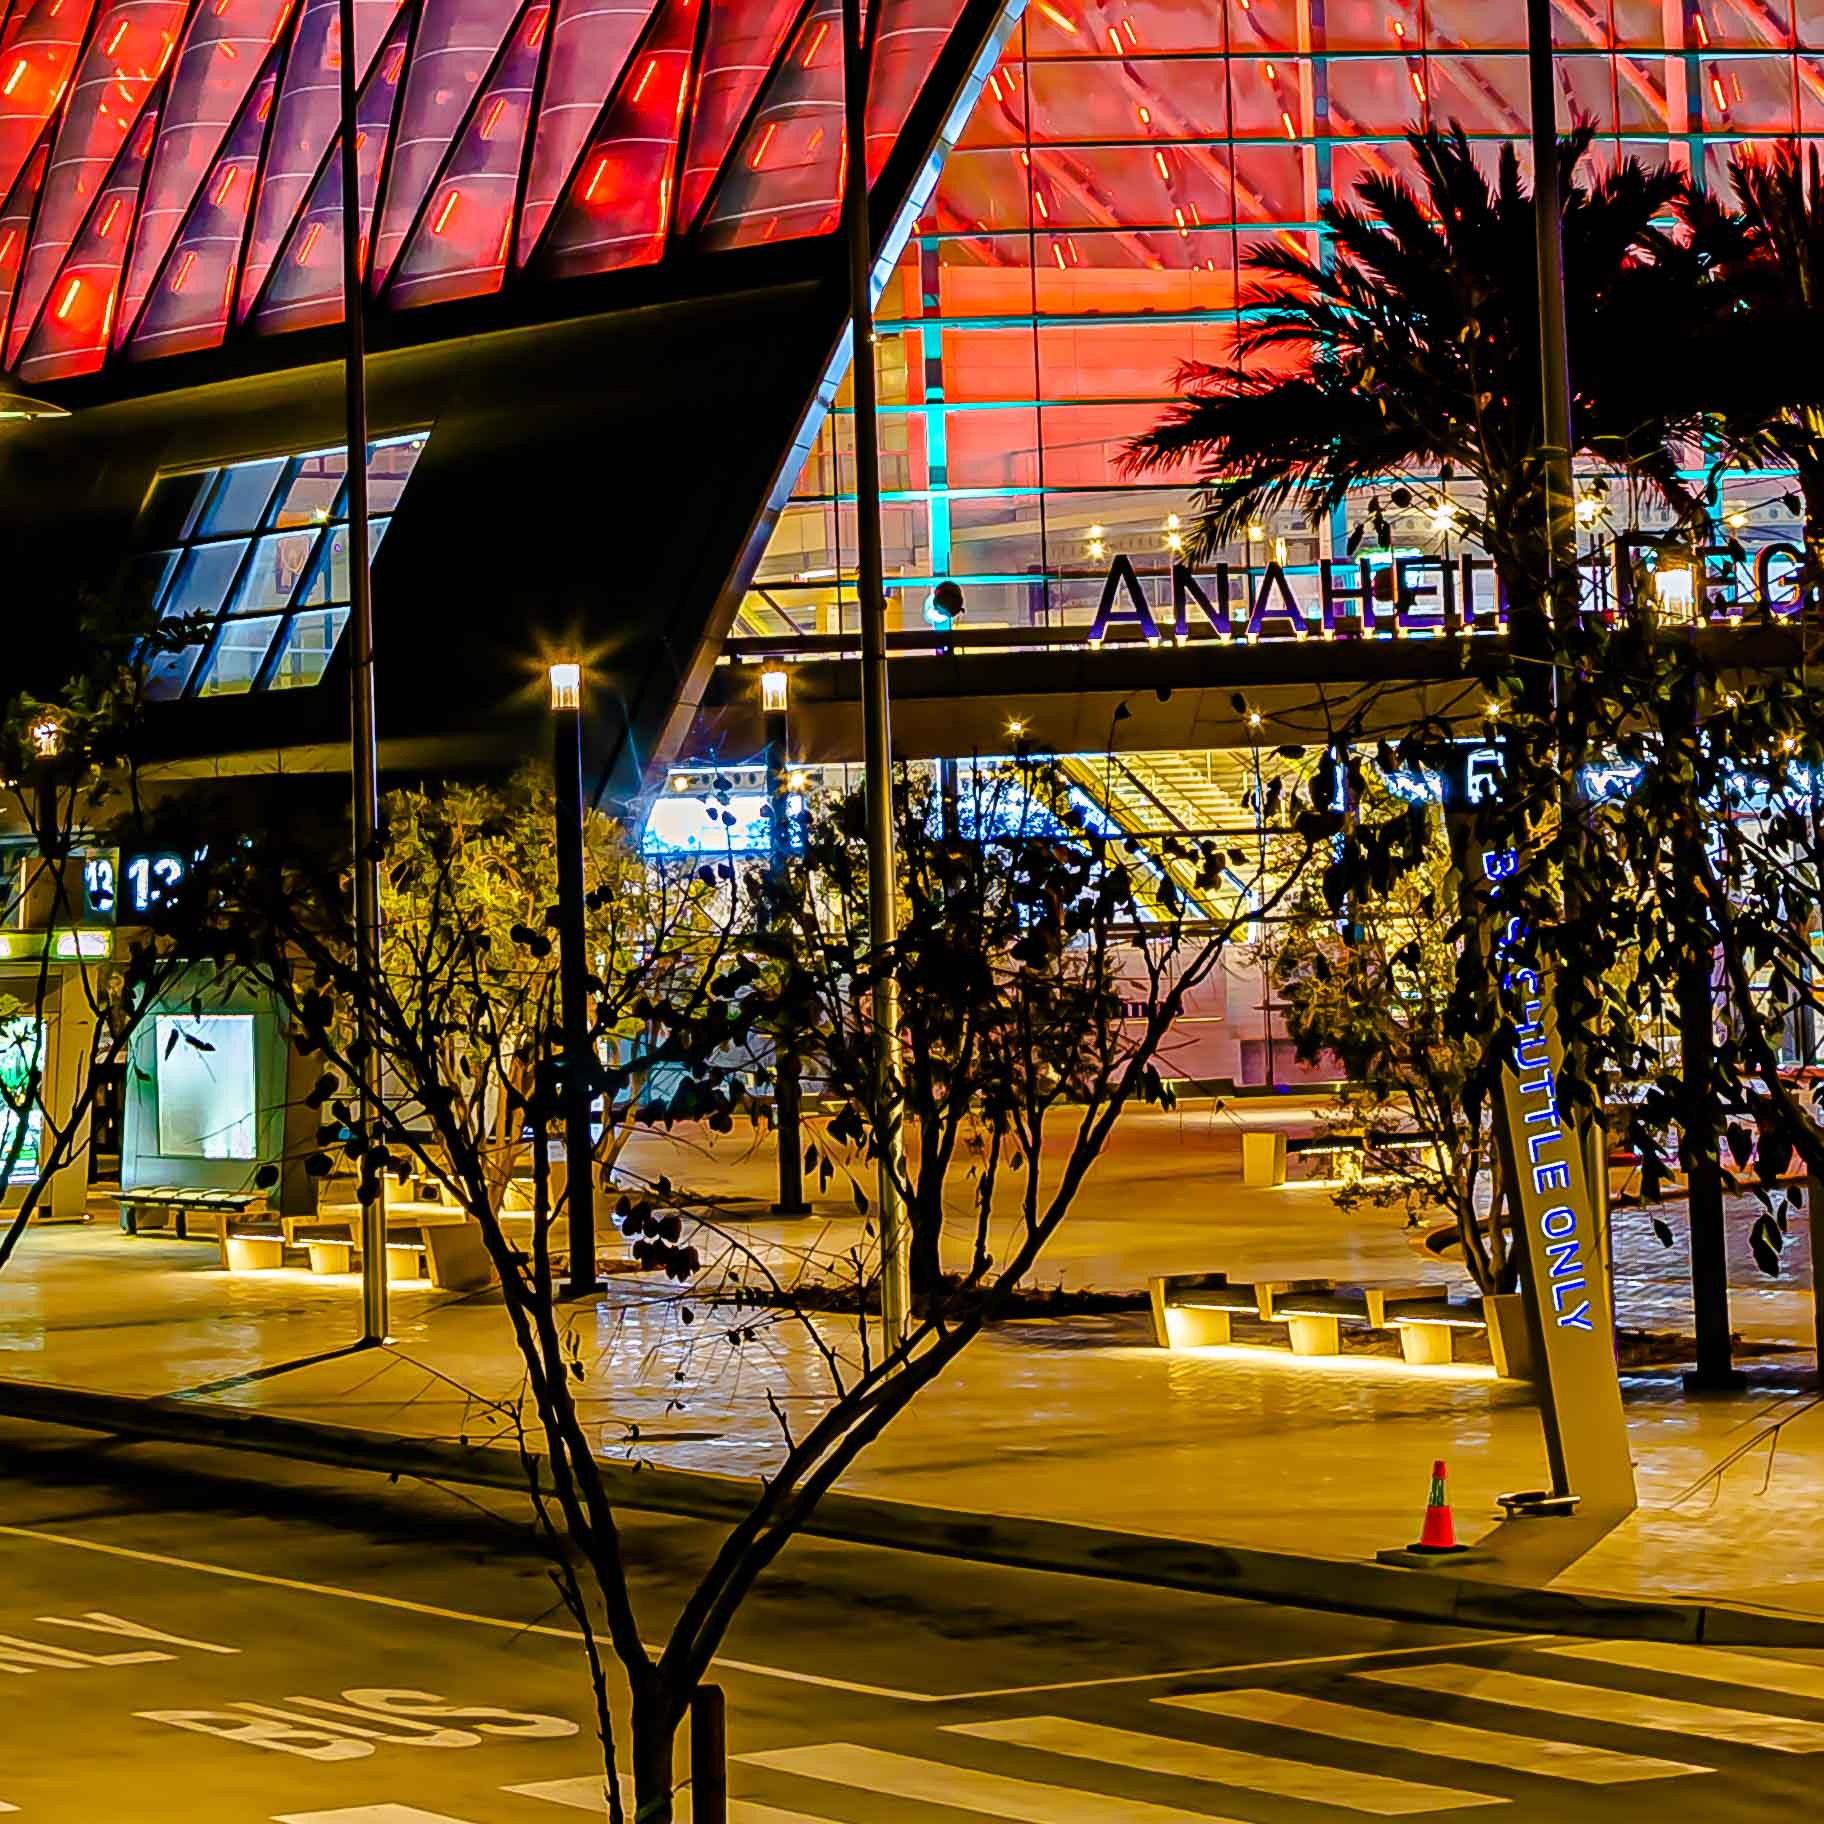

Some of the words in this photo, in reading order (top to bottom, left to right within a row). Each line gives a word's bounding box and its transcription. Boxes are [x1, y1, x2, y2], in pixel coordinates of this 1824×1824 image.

[1087, 551, 1510, 642] ANAHEI
[1539, 1204, 1594, 1331] ONLY
[131, 1688, 581, 1762] BUS
